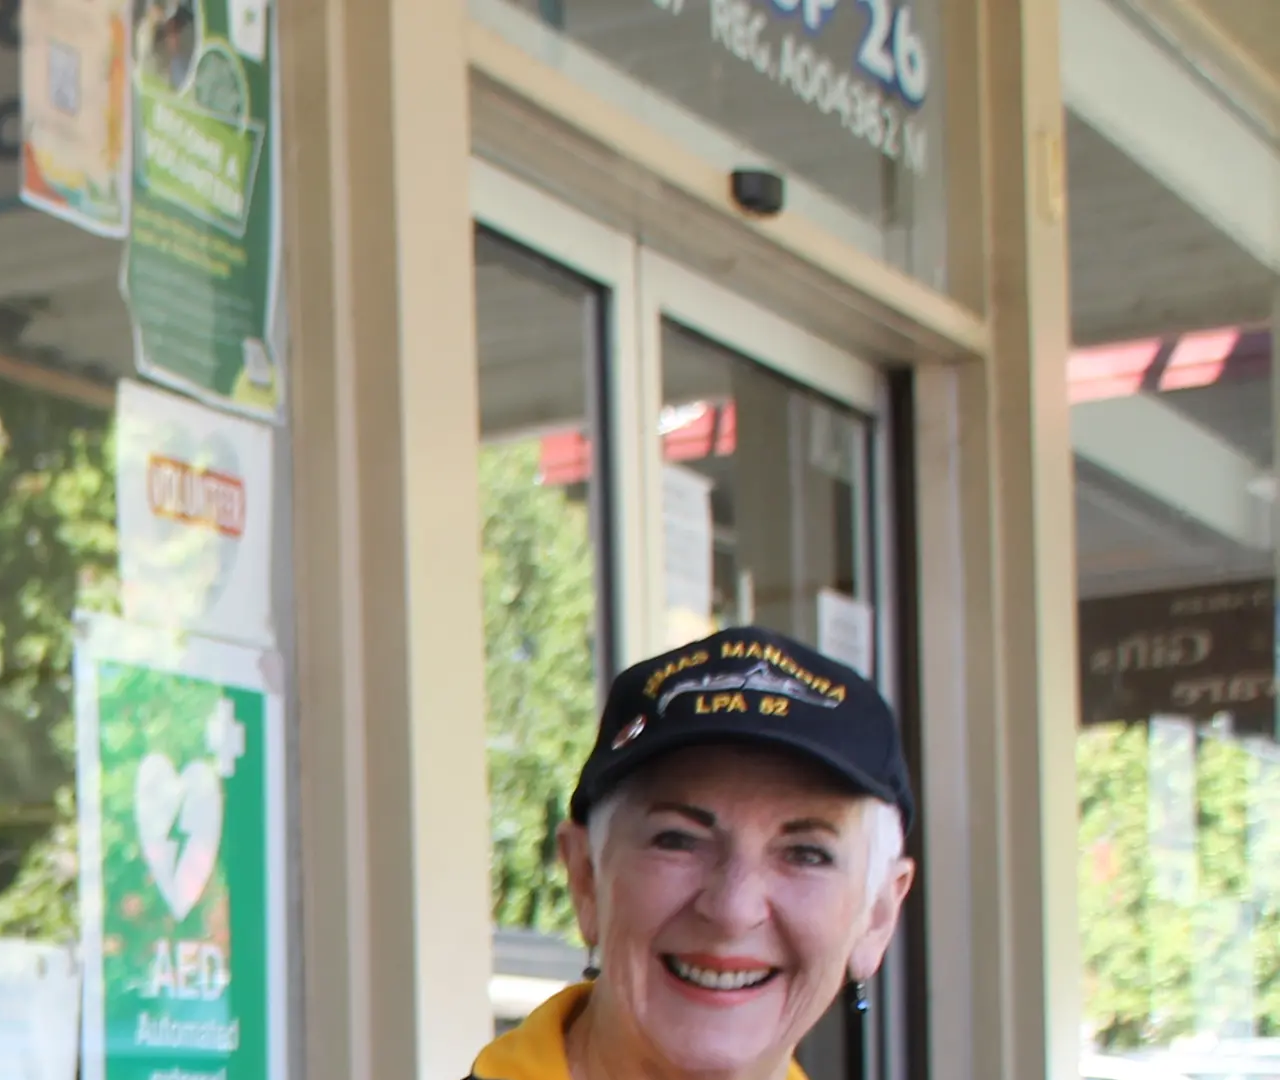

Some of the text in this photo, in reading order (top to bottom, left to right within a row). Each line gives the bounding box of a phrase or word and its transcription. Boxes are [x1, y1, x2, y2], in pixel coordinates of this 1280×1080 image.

[695, 693, 748, 715] LPA
[140, 937, 230, 1002] AED
[134, 1011, 240, 1052] Automated
